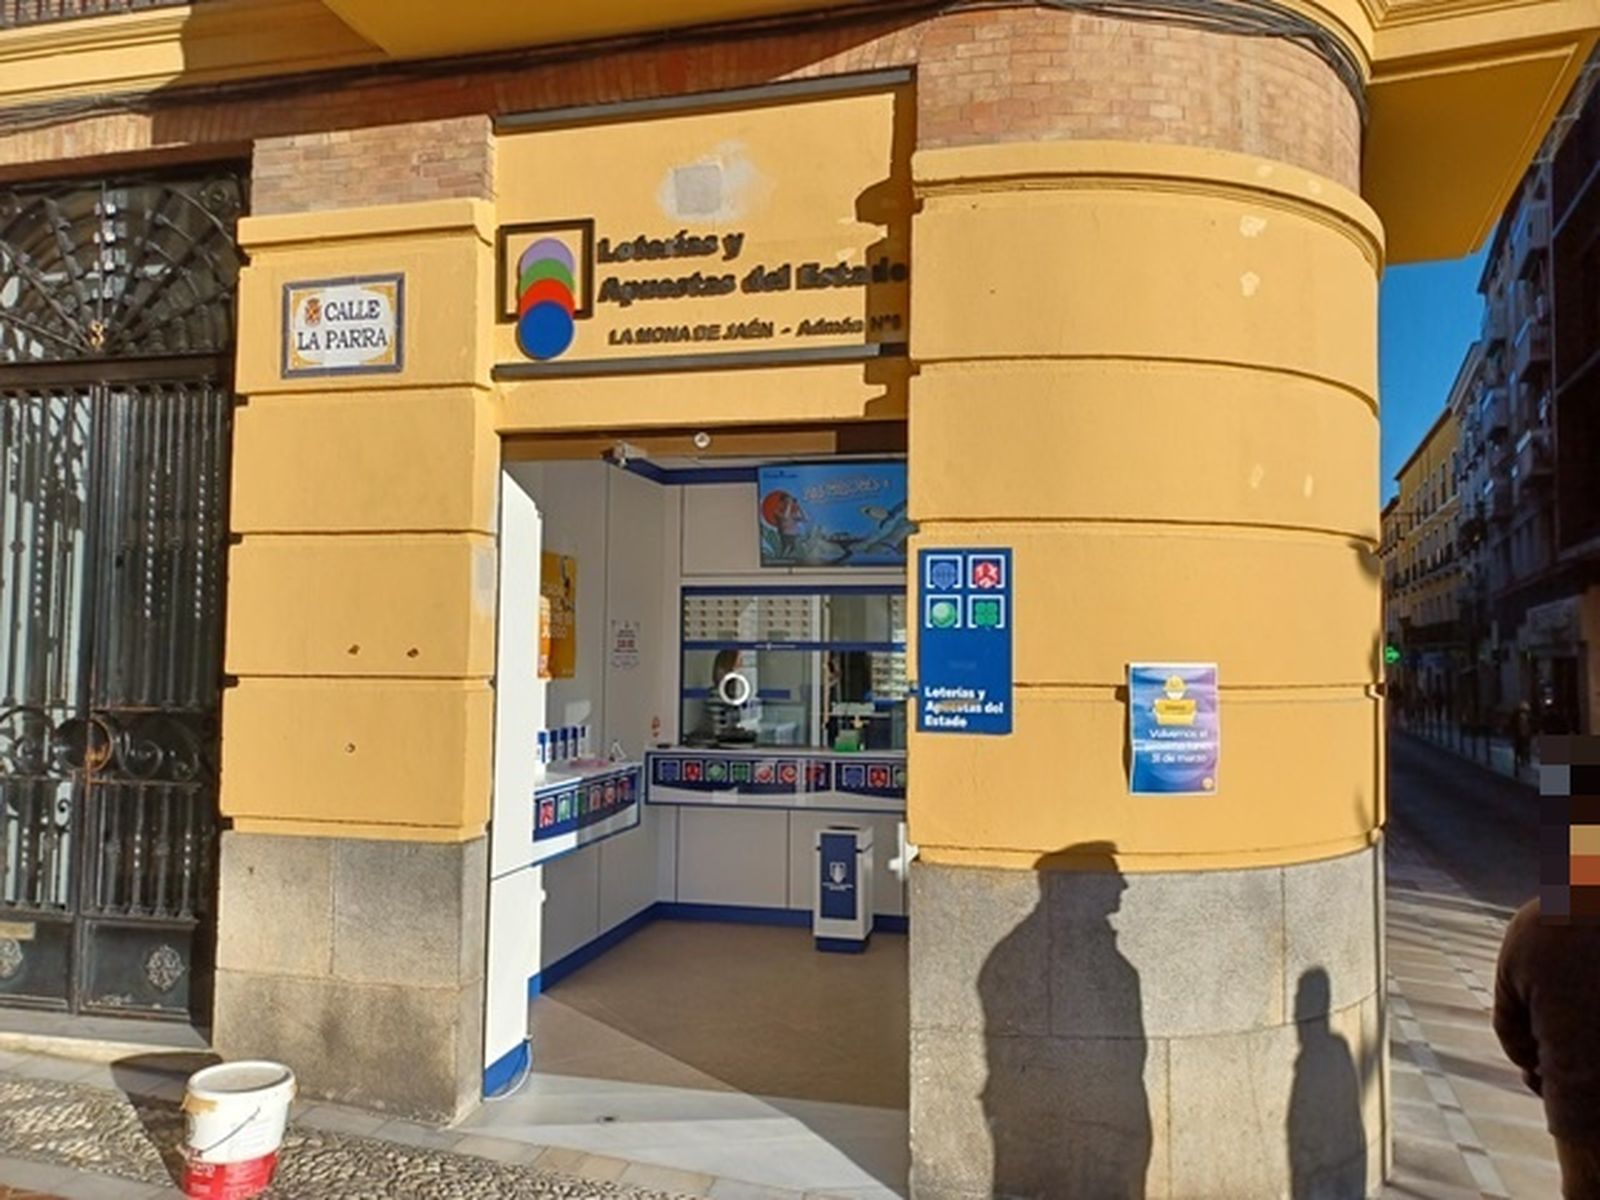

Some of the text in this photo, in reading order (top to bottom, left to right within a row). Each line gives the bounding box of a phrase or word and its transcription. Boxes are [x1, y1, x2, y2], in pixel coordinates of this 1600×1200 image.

[597, 230, 744, 263] Loterías y
[597, 257, 908, 307] Apuestas del Estado
[324, 299, 380, 321] CALLE
[297, 327, 388, 350] LA PARRA
[608, 328, 633, 345] LA
[635, 325, 690, 343] MONA
[692, 324, 721, 342] DE
[722, 317, 774, 339] JAÉN
[924, 686, 986, 701] Loterías y
[985, 702, 1004, 713] del
[924, 715, 967, 728] Estado
